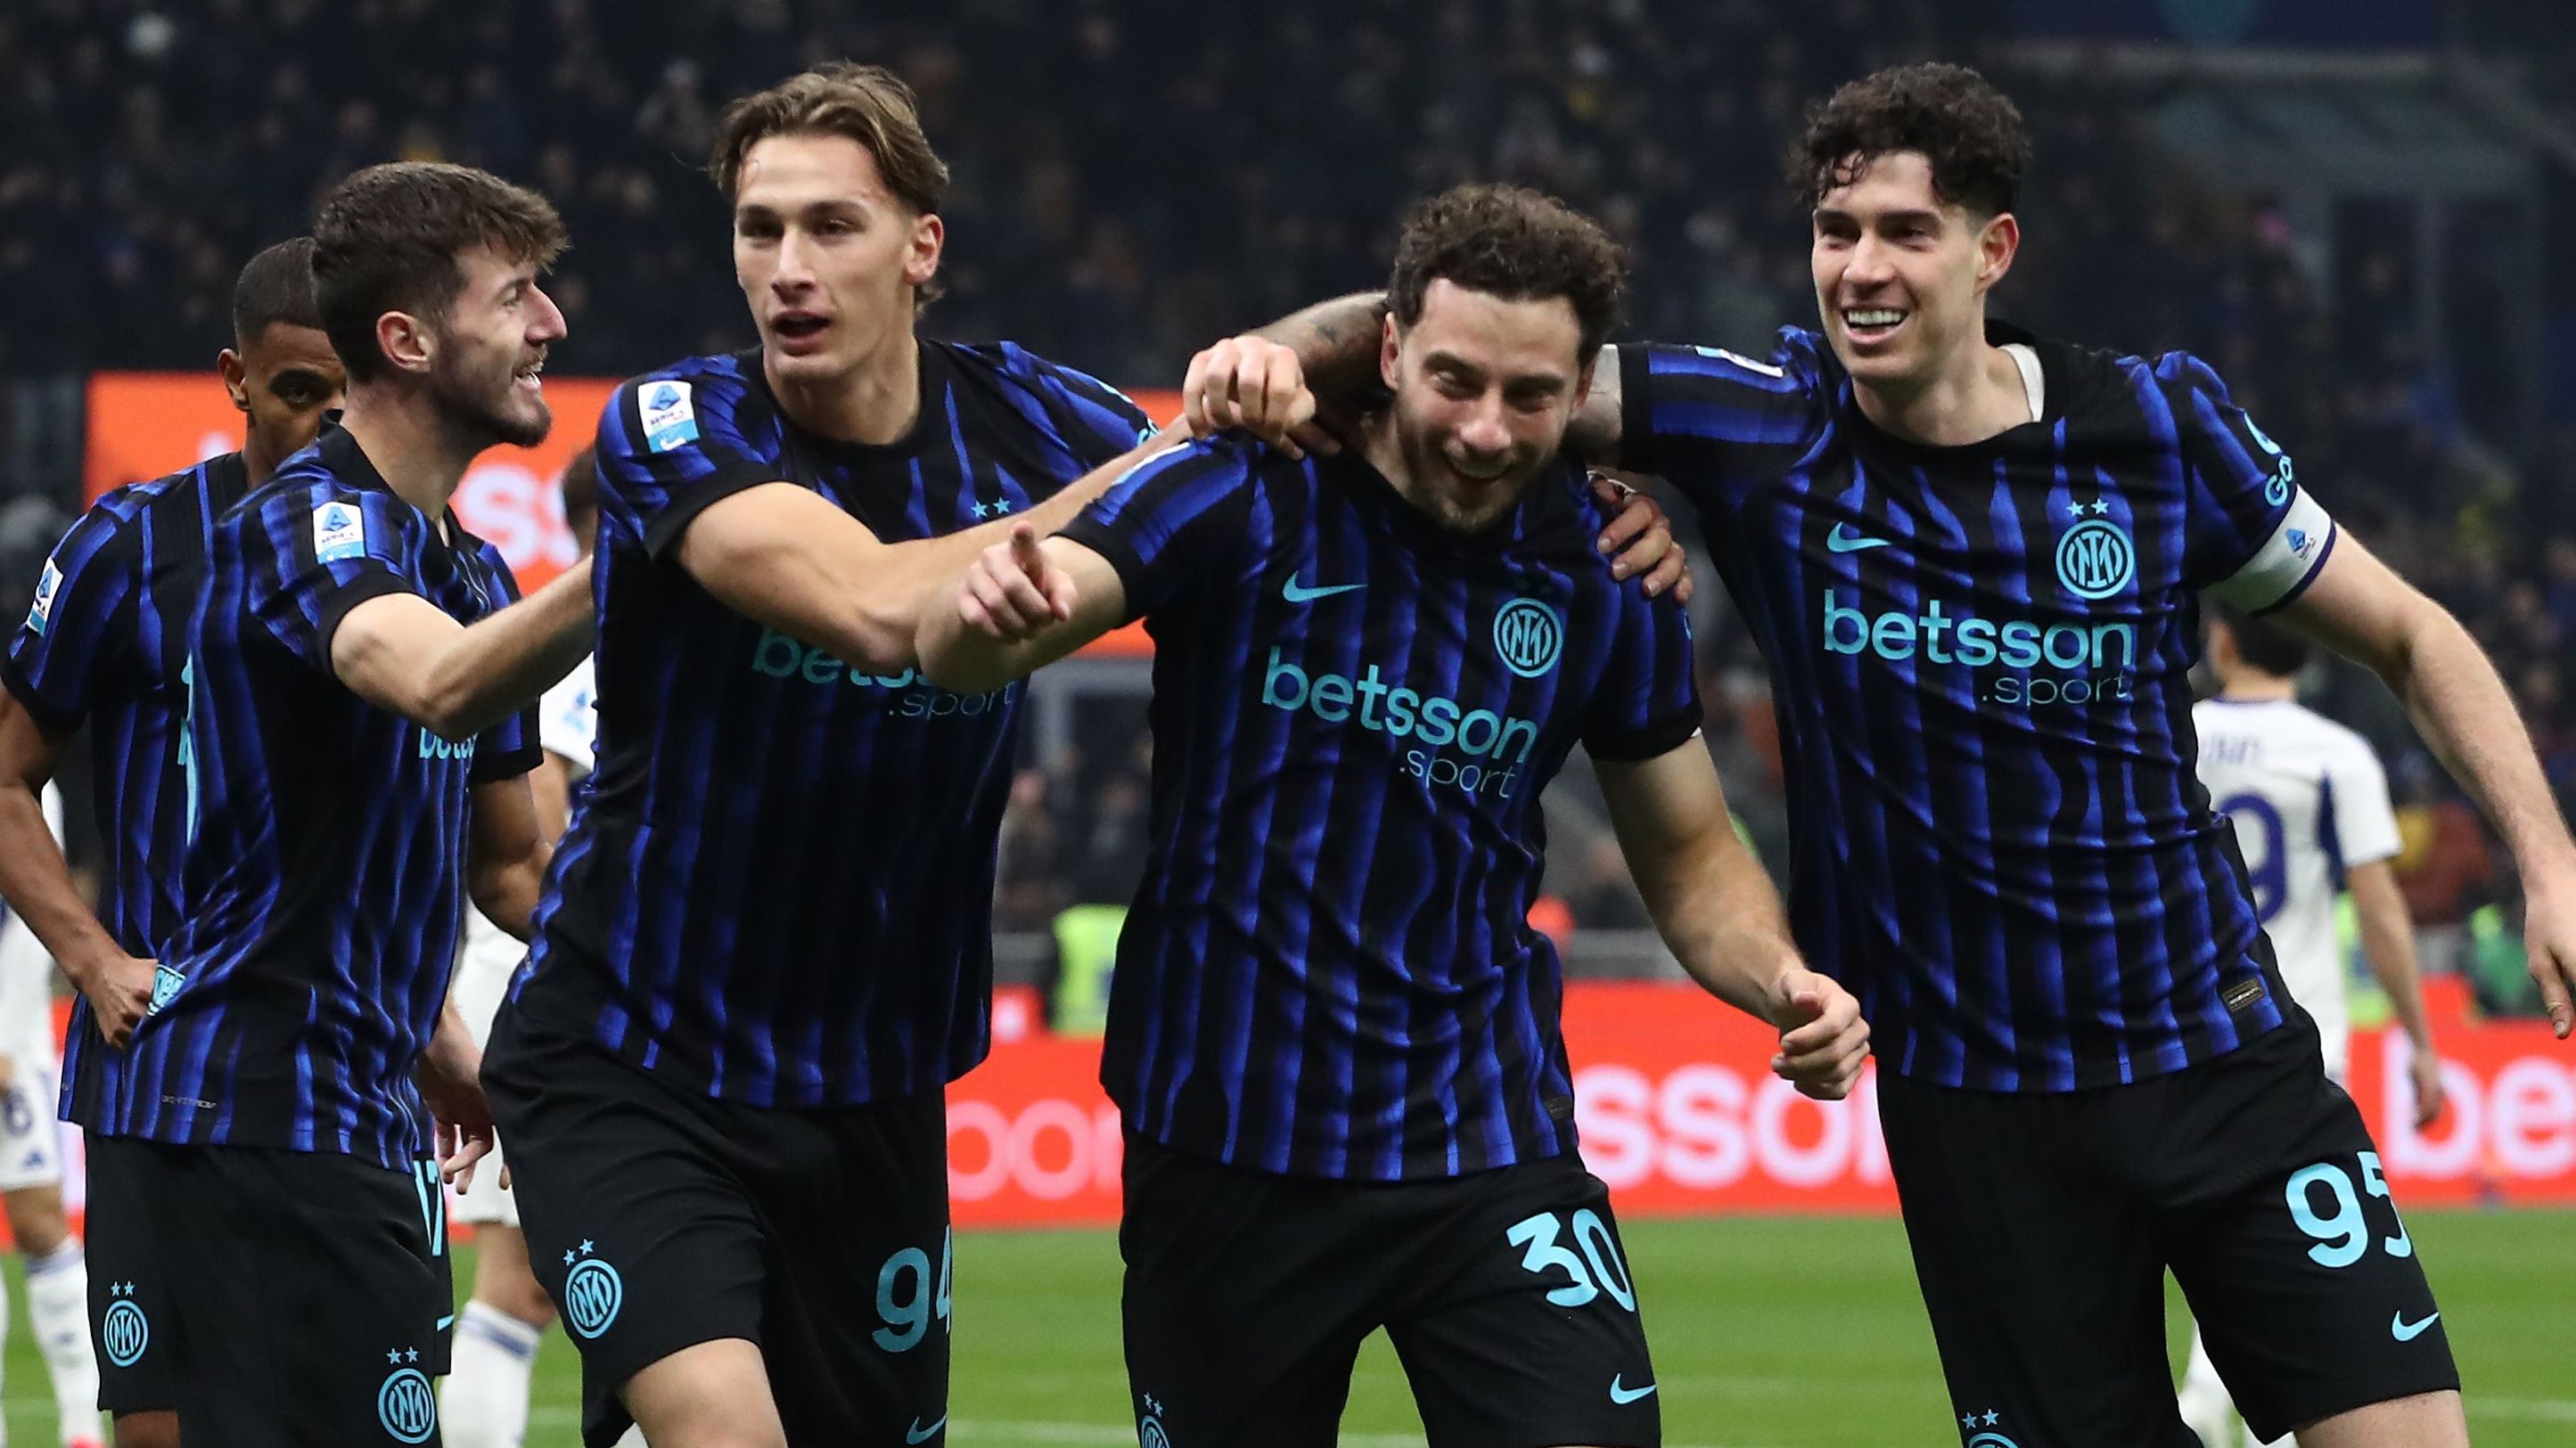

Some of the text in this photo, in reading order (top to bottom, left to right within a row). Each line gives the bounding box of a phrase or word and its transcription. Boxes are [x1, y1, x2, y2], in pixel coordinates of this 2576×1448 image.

[1825, 589, 2132, 669] betsson
[1262, 644, 1538, 763] betsson
[1982, 670, 2128, 710] .sport
[1400, 749, 1516, 798] .sport
[1505, 1207, 1636, 1313] 30
[2285, 1150, 2412, 1268] 95
[872, 1223, 951, 1353] 94
